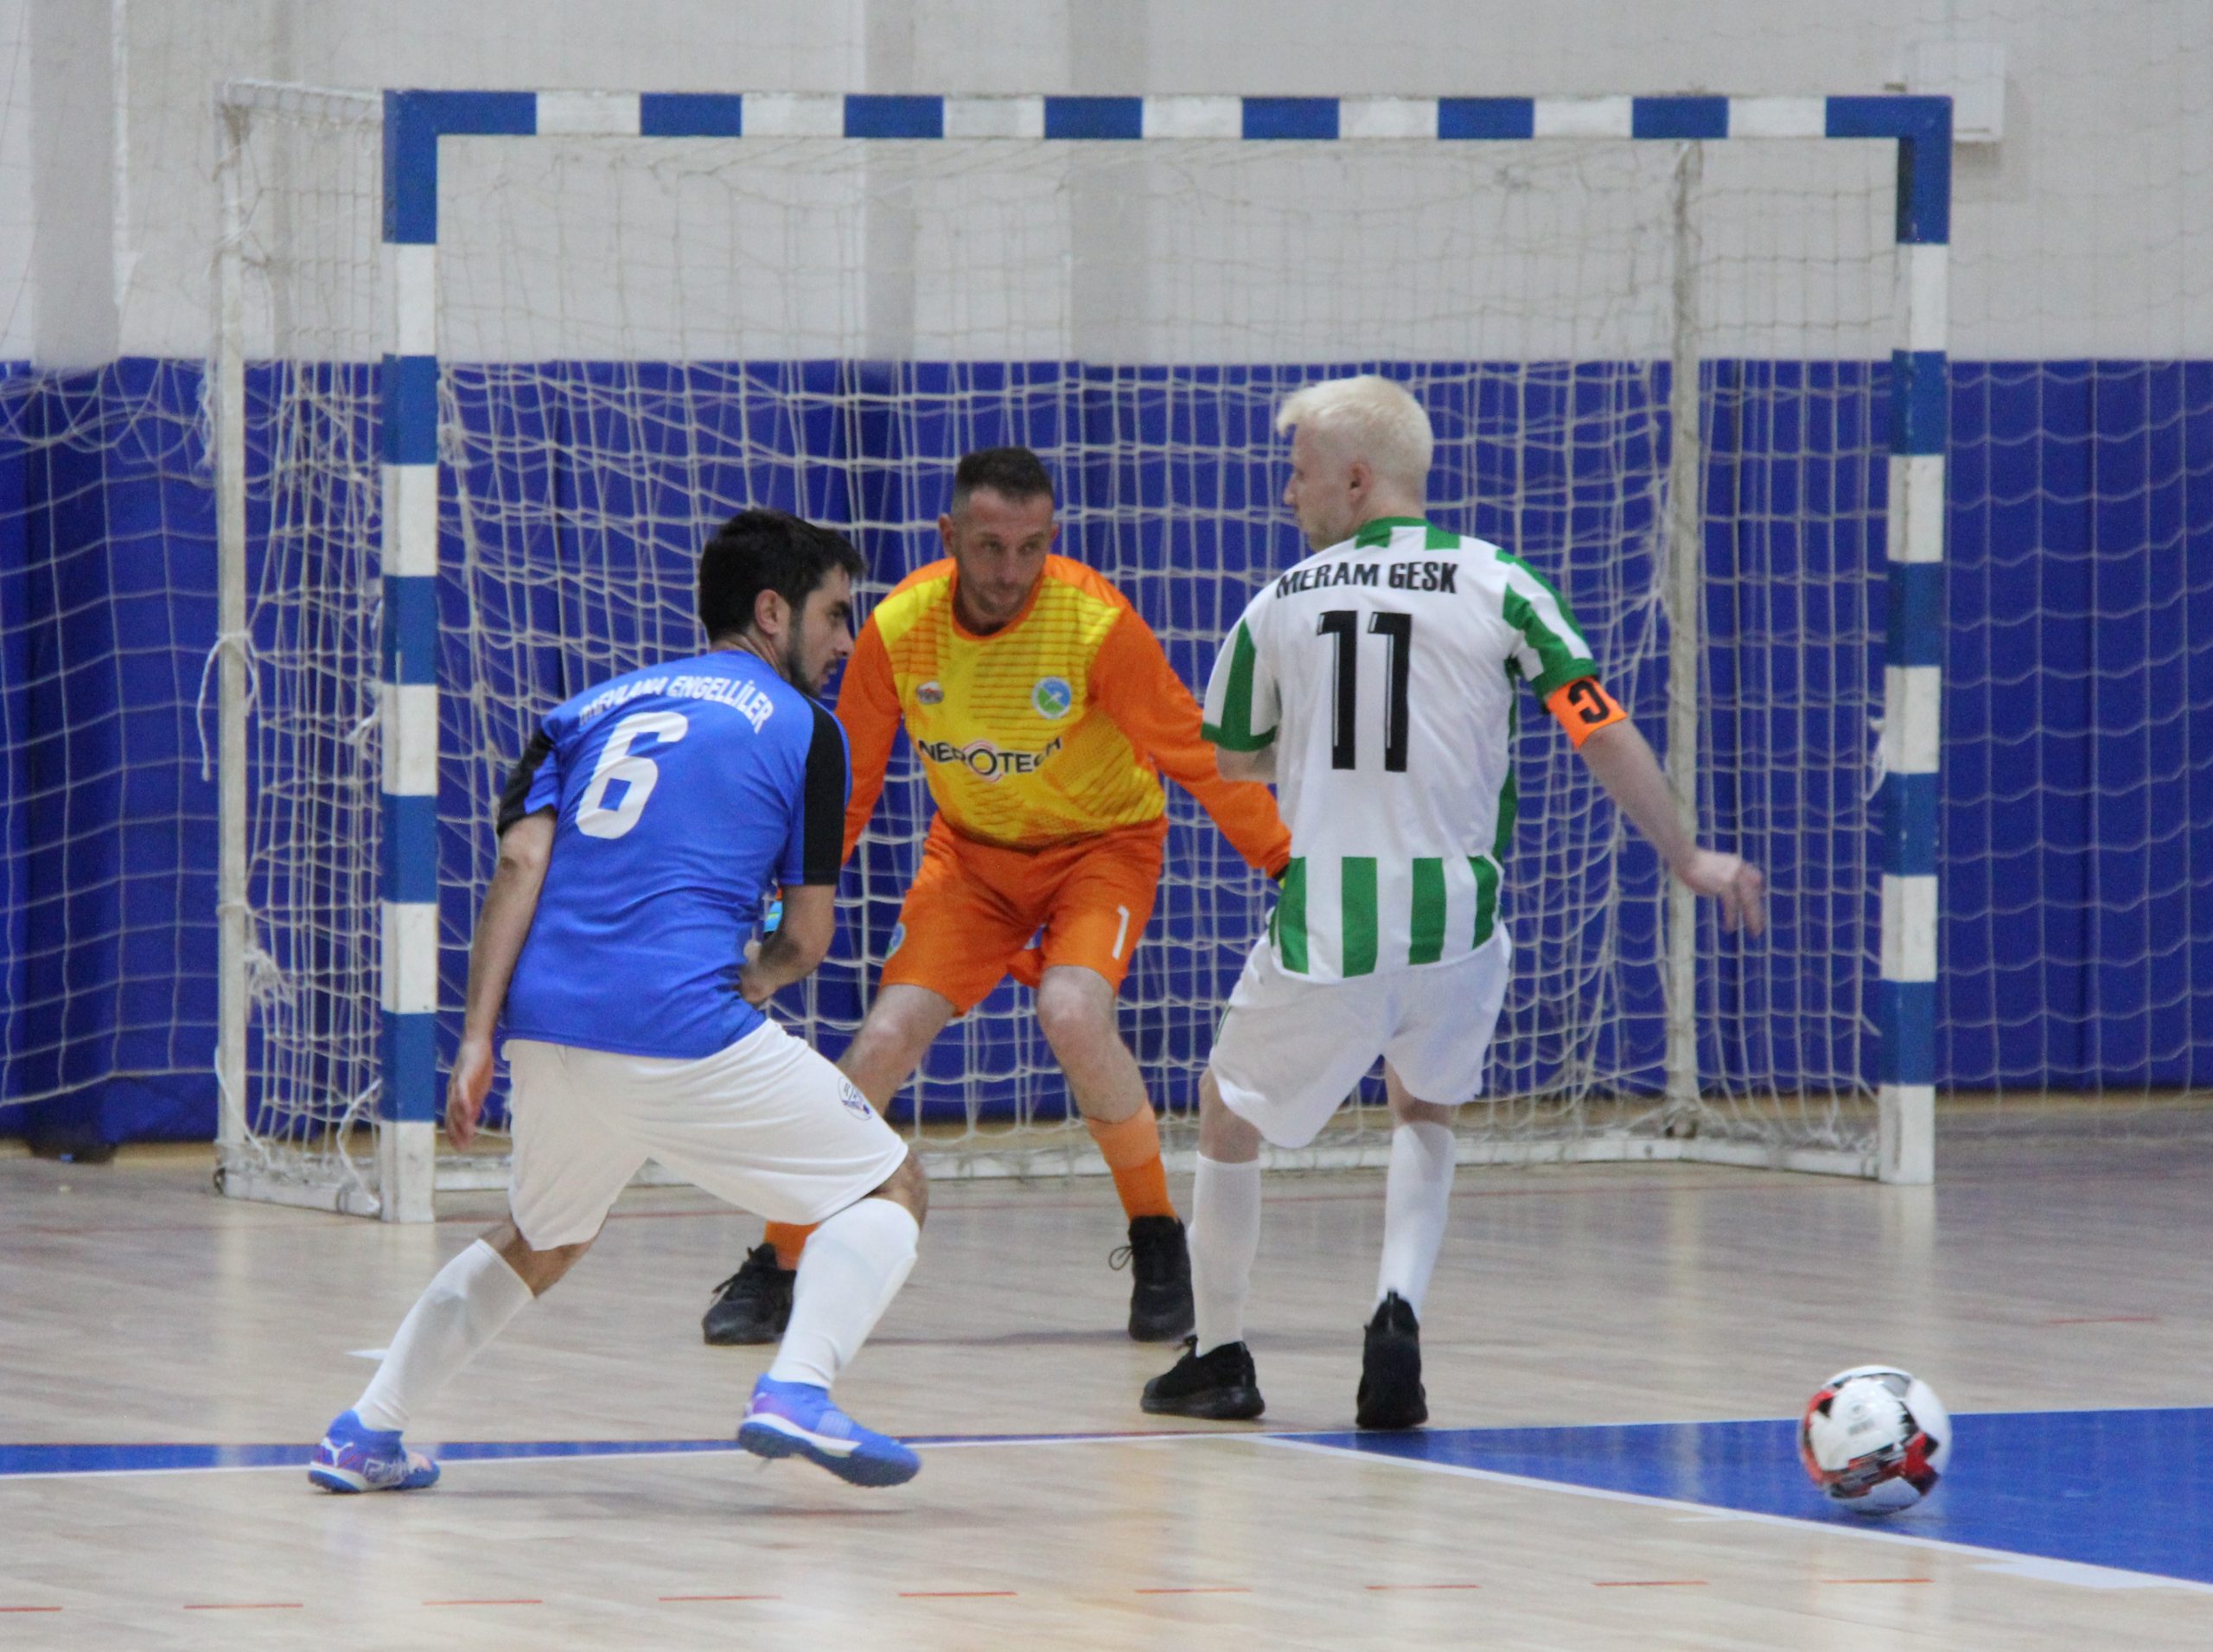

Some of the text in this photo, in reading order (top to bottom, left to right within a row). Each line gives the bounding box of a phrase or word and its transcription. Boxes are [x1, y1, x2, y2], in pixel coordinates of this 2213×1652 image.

[1276, 561, 1461, 599] MERAM GESK
[1316, 609, 1413, 772] 11
[575, 711, 689, 839] 6
[1112, 904, 1130, 960] 1
